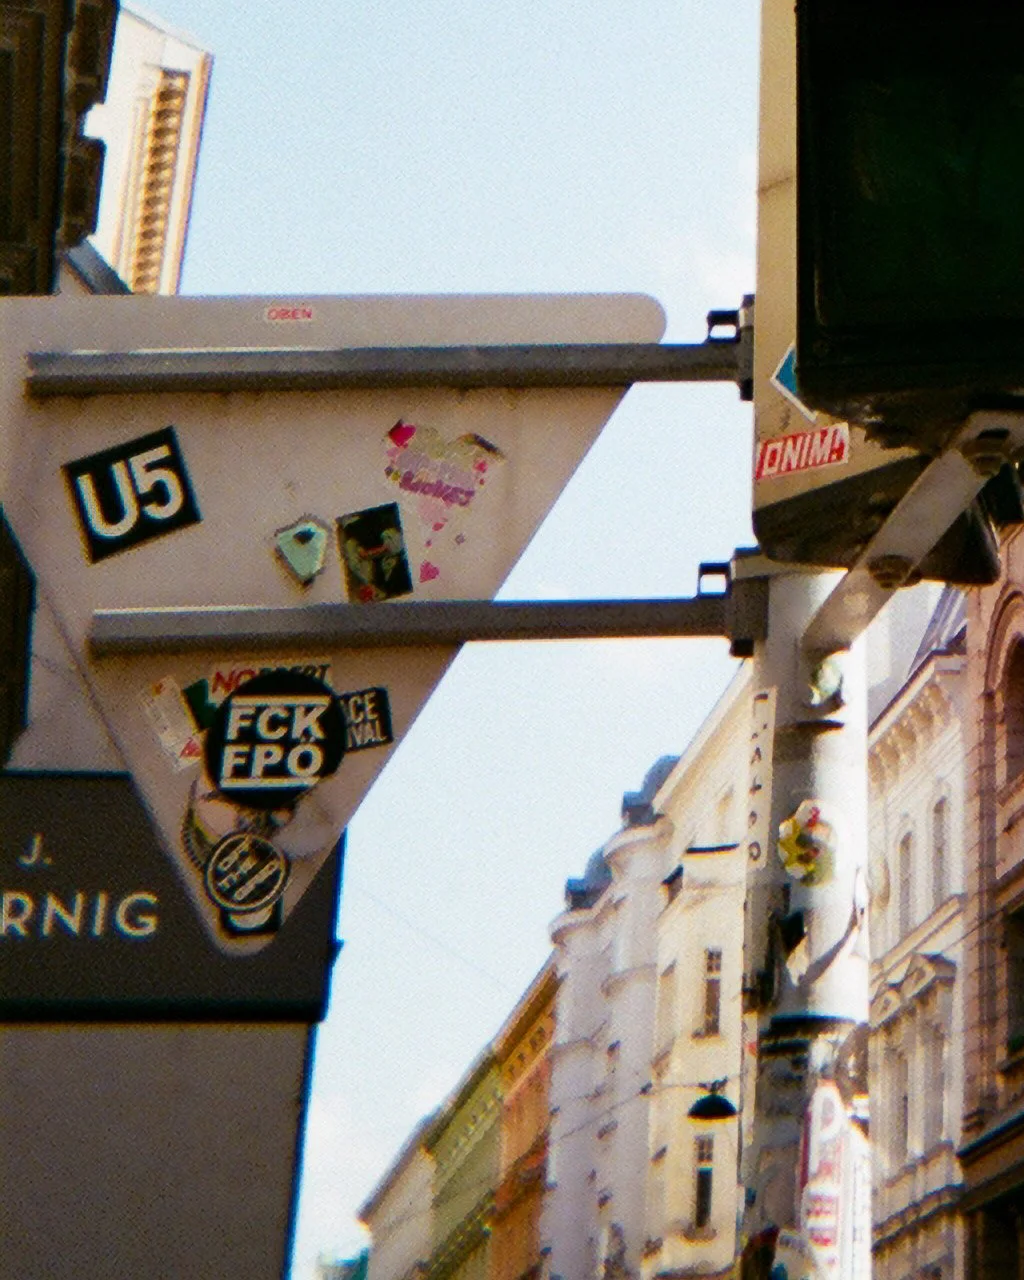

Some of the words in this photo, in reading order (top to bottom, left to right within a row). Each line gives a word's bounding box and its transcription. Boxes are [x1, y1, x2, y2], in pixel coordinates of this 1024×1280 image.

[76, 444, 184, 538] U5
[226, 704, 327, 741] FCK
[222, 733, 324, 779] FPÖ
[18, 832, 53, 866] J.
[0, 890, 160, 937] RNIG
